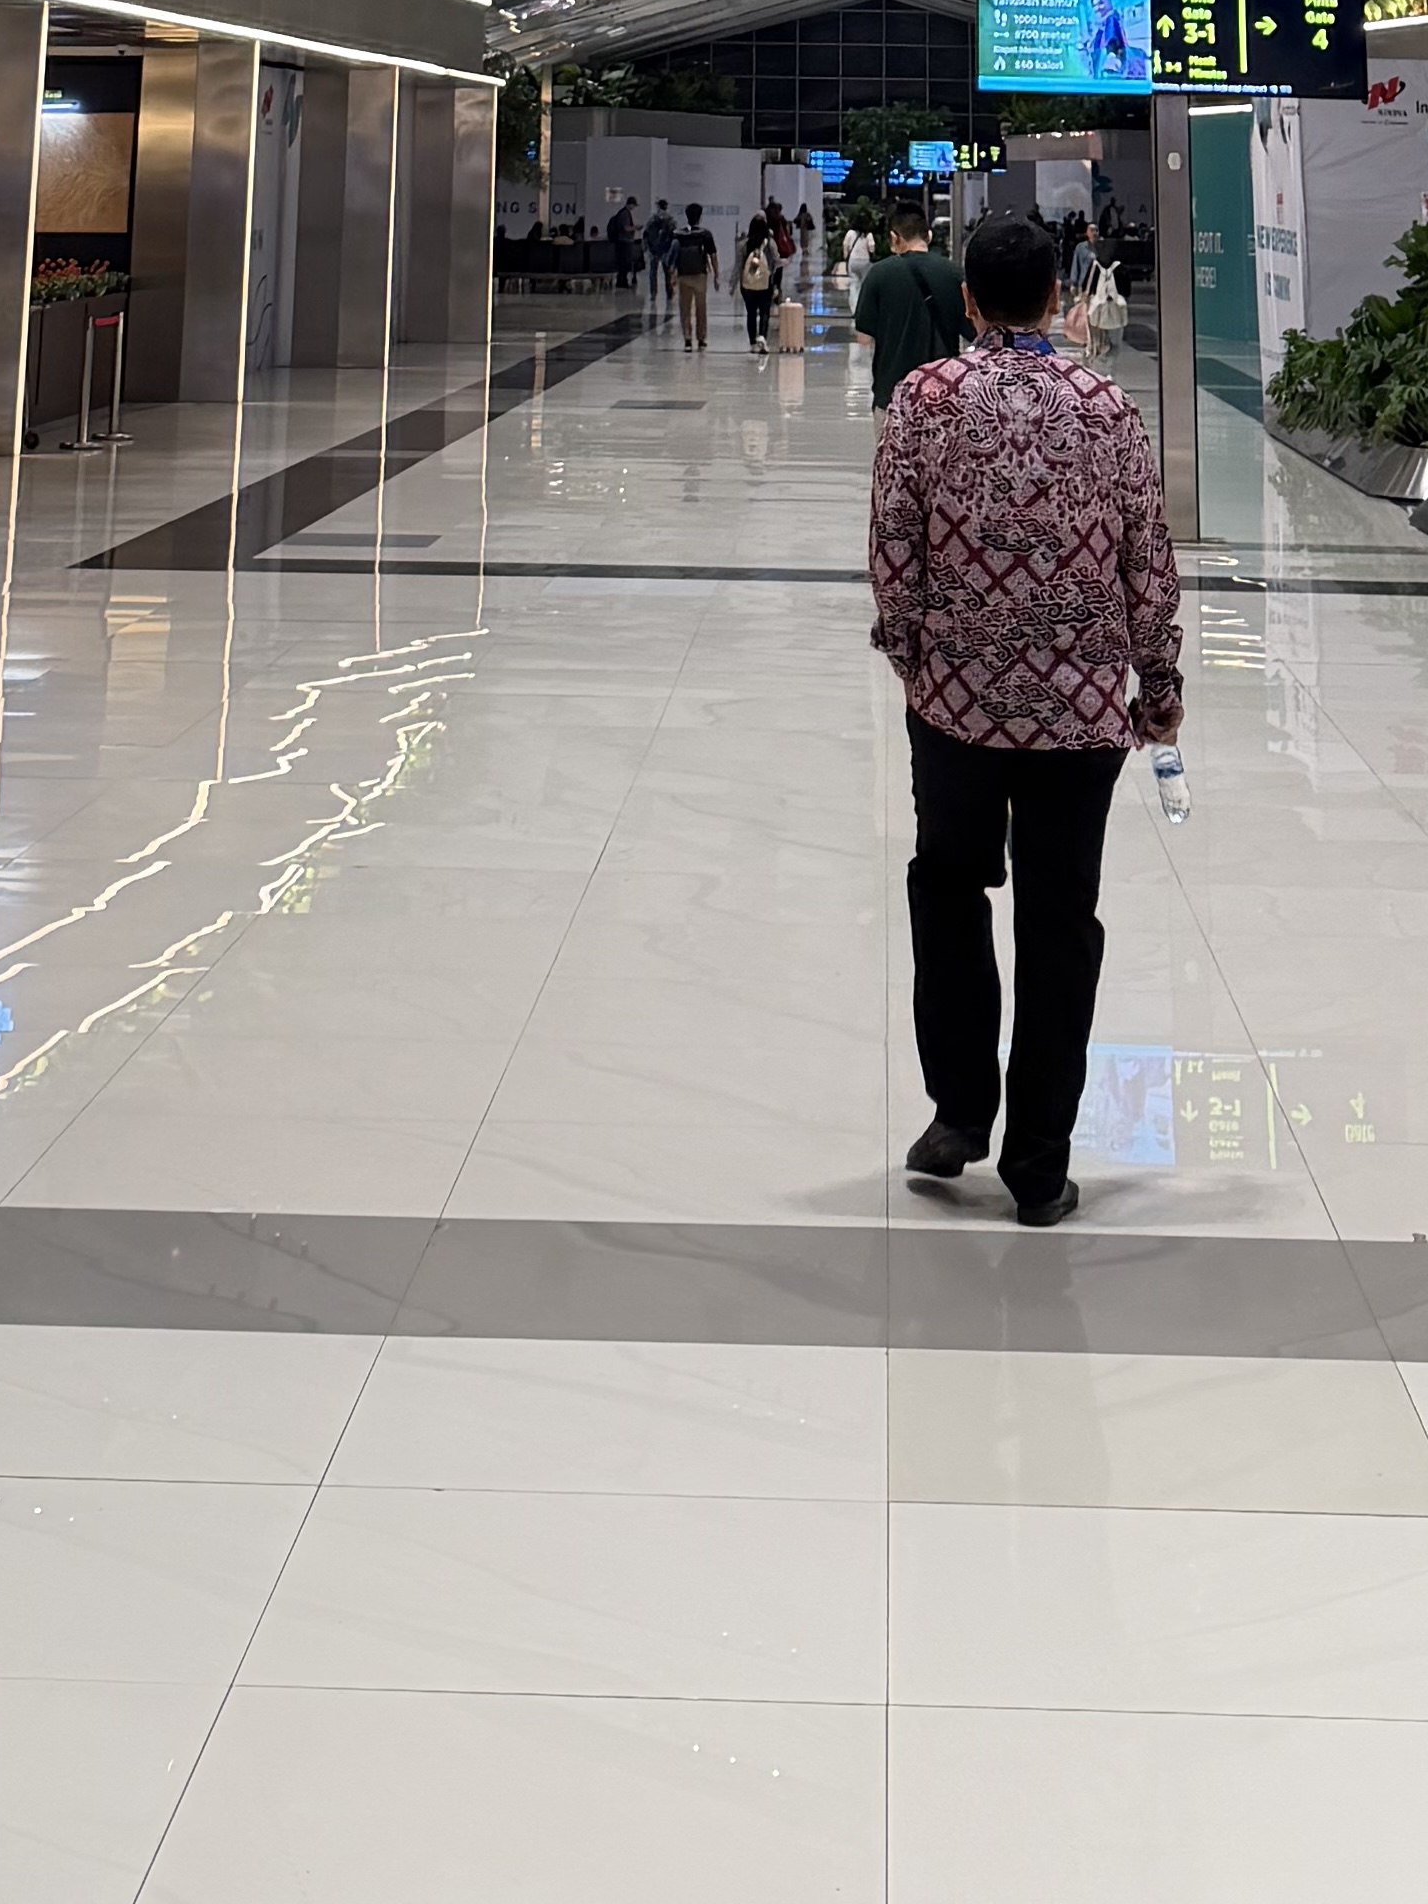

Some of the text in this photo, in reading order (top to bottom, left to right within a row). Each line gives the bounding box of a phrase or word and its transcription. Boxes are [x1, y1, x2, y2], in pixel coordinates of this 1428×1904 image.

[1182, 7, 1213, 21] Gate
[1304, 10, 1336, 25] Gate
[1182, 22, 1216, 45] 3-1
[1311, 28, 1330, 51] 4
[527, 201, 578, 216] SON
